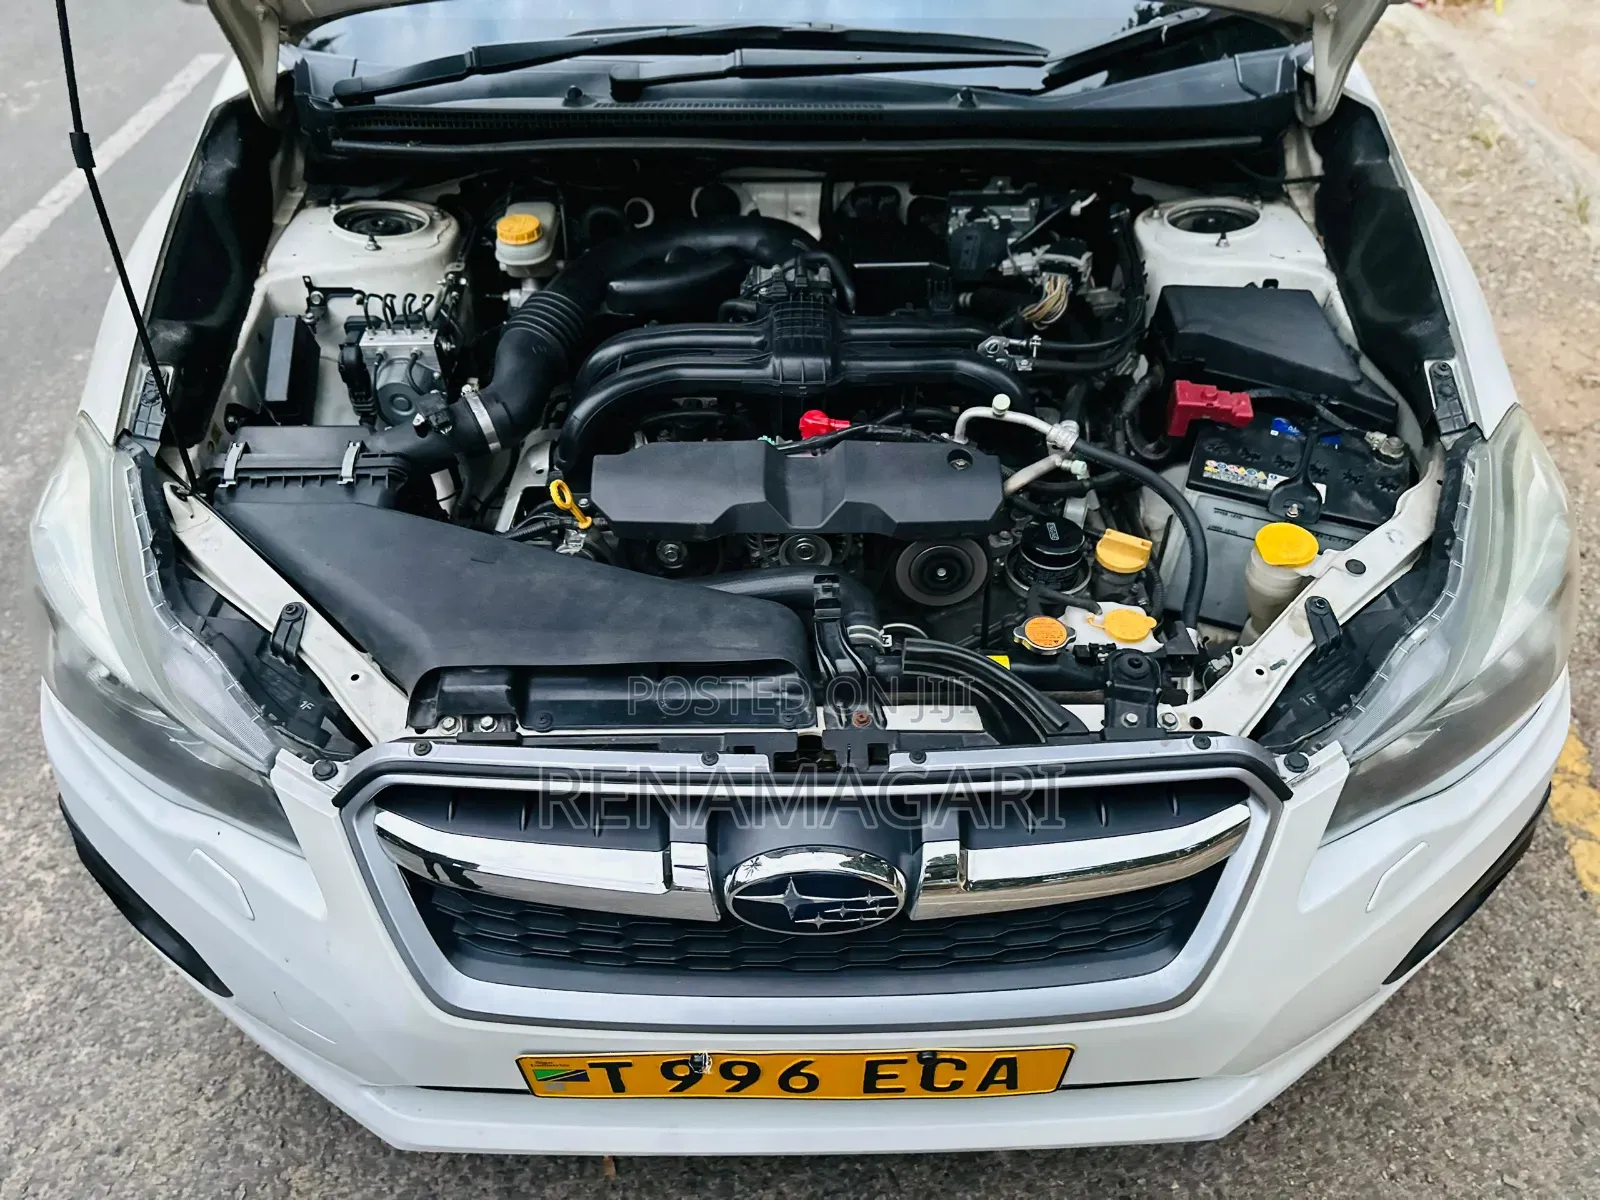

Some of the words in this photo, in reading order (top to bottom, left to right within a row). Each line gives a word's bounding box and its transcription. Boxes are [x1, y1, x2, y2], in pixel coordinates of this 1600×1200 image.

[587, 1061, 633, 1094] T
[660, 1058, 820, 1094] 996
[862, 1055, 1019, 1094] ECA
